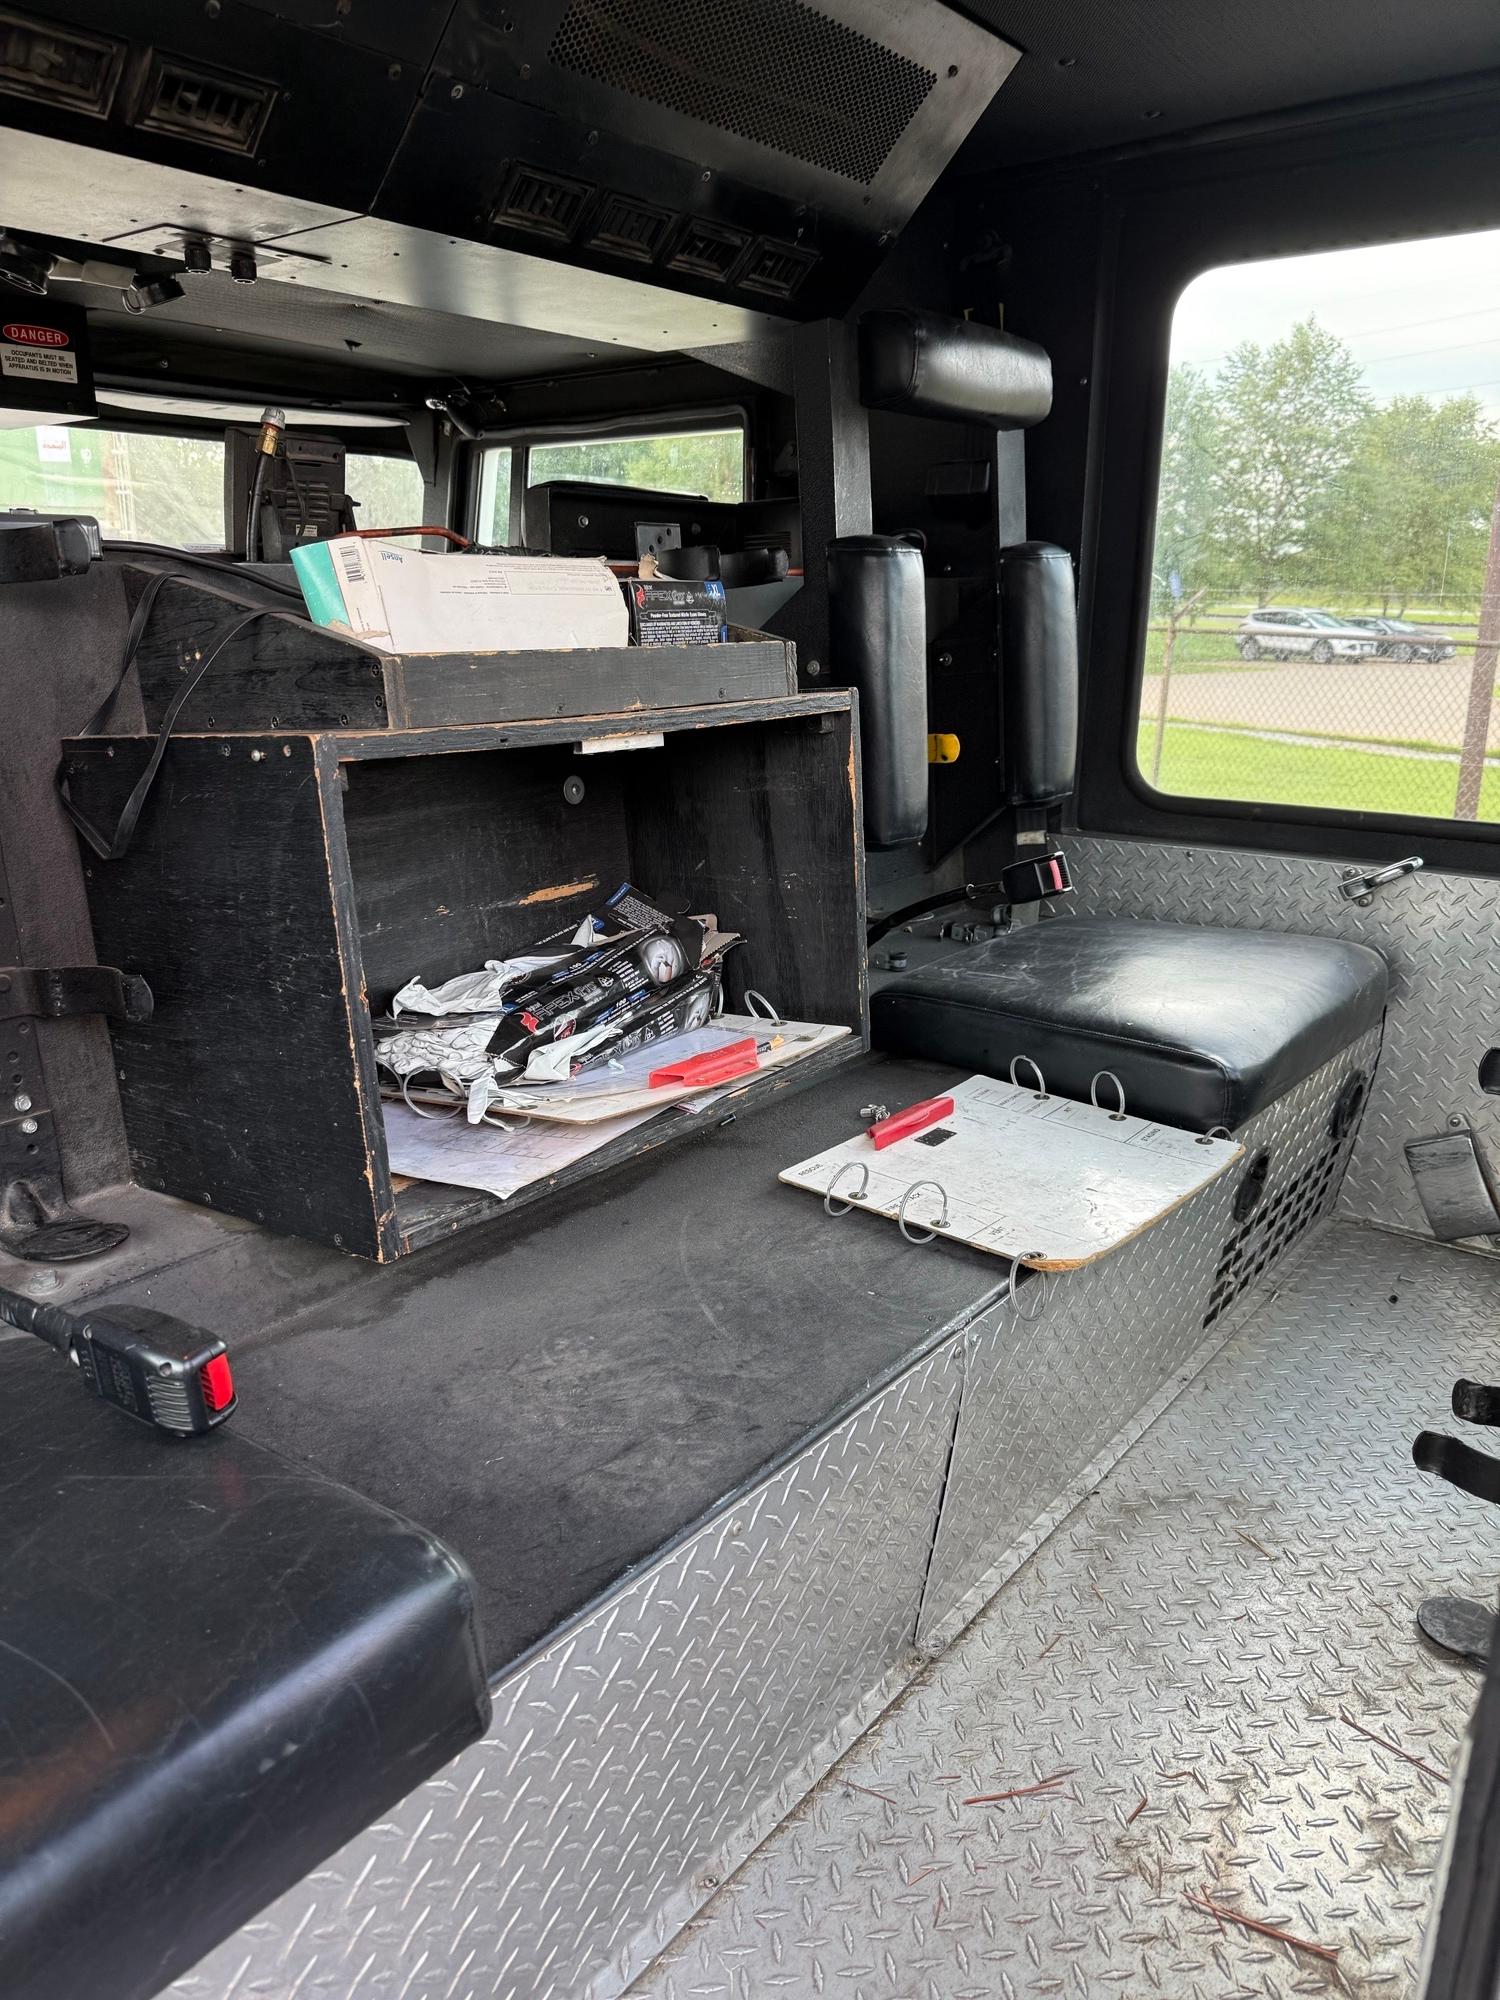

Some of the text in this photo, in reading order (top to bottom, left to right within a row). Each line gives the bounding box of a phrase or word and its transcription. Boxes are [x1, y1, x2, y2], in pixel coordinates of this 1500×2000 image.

[11, 327, 62, 344] DANGER
[4, 355, 26, 363] SEATED
[38, 359, 58, 367] BELTED
[11, 350, 43, 359] OCCUPANTS
[43, 353, 57, 361] MUST
[8, 362, 39, 371] APPARATUS
[381, 551, 404, 564] Ansell
[532, 989, 580, 1021] APEX
[797, 1163, 824, 1176] RESCUE
